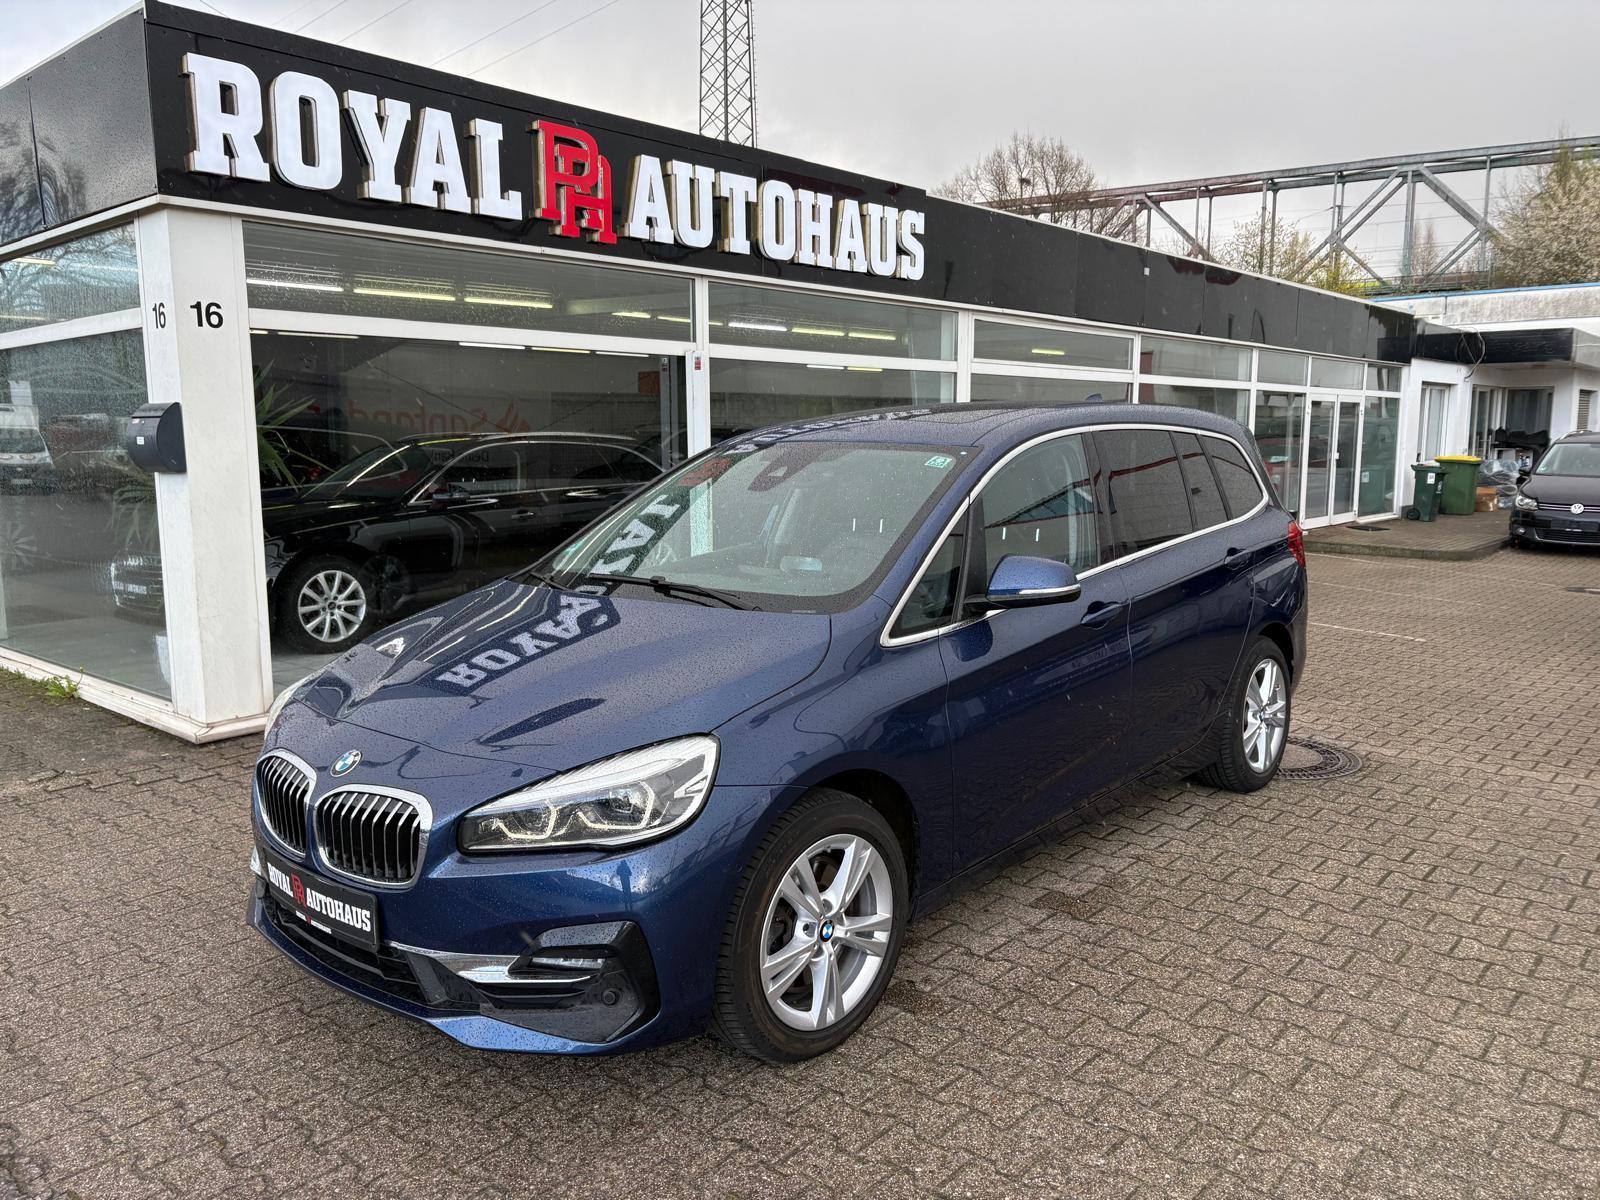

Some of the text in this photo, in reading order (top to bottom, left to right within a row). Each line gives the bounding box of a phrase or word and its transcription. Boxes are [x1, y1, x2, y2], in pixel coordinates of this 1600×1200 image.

[182, 52, 523, 221] ROYAL
[624, 154, 925, 281] AUTOHAUS
[152, 302, 166, 329] 16
[190, 301, 223, 329] 16
[306, 887, 371, 932] AUTOHAUS
